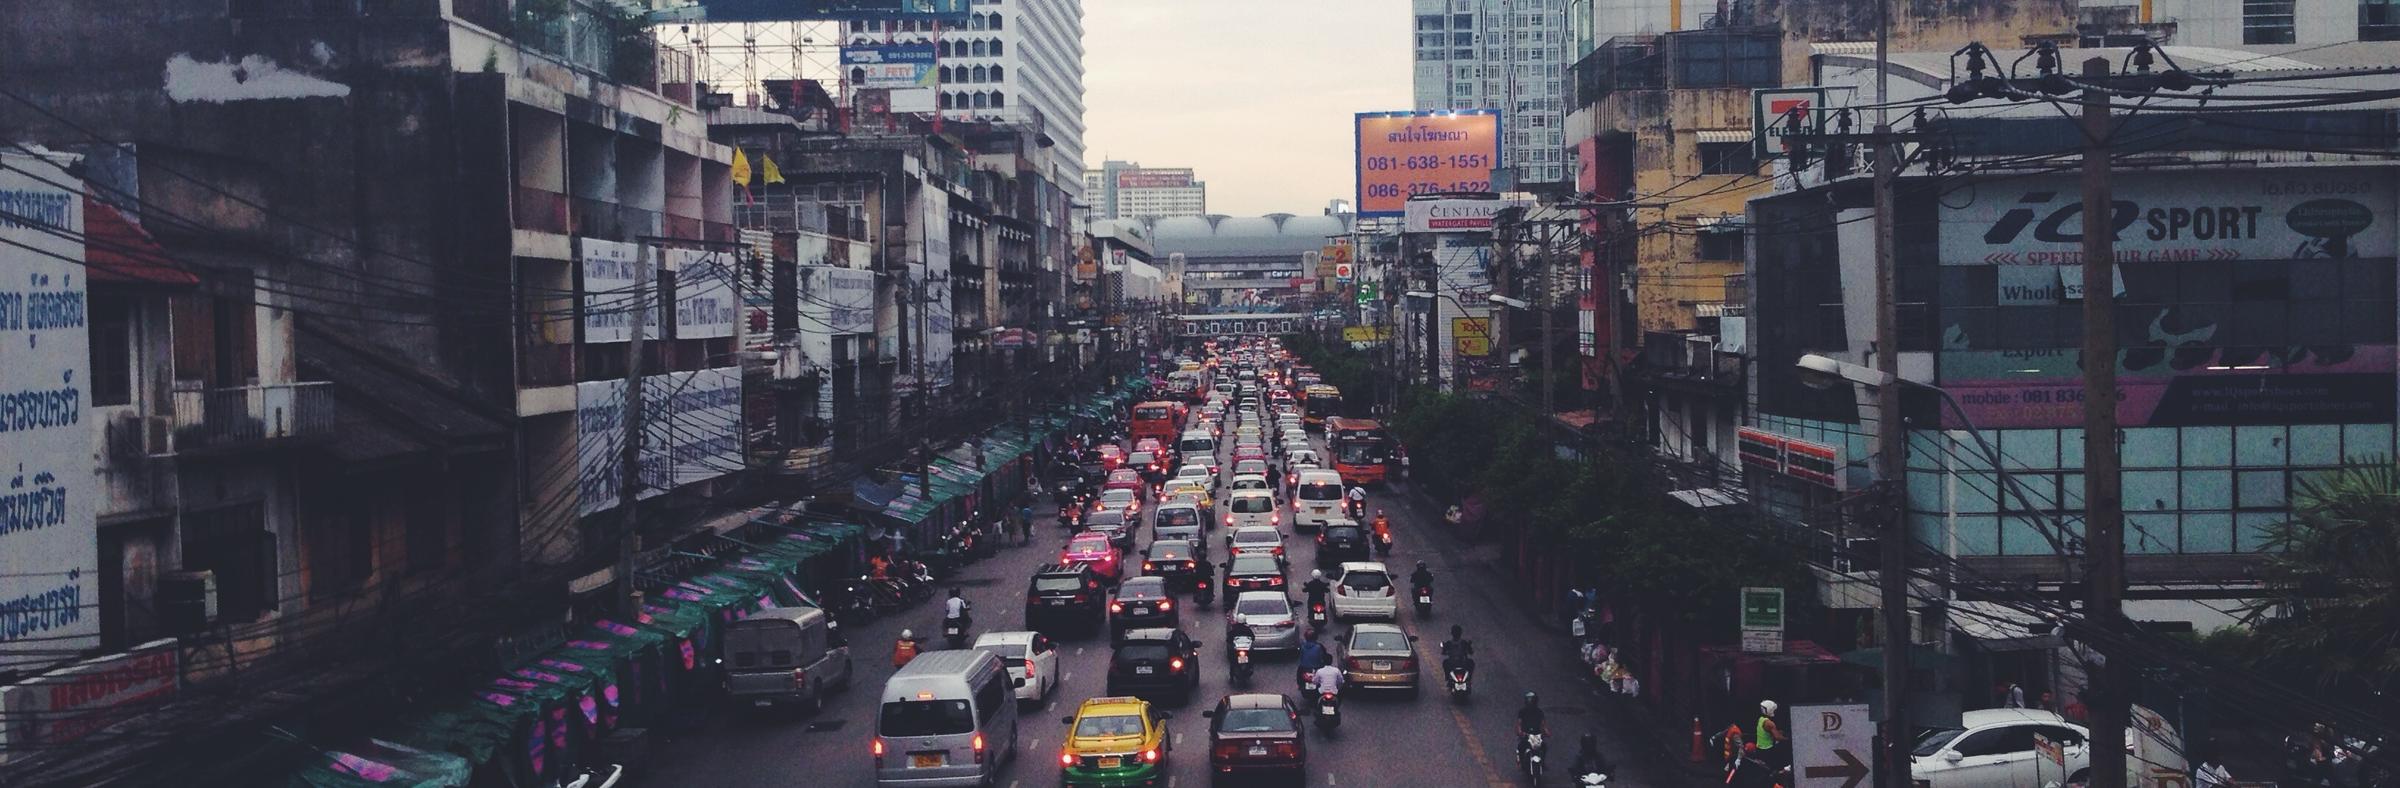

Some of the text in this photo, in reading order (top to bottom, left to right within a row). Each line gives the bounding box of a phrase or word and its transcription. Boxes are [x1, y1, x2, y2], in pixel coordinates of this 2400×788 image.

[1388, 126, 1468, 143] สนใจโฆษณา
[1367, 154, 1489, 171] 081-638-1551
[2146, 205, 2263, 241] SPORT
[2147, 248, 2200, 263] GAME
